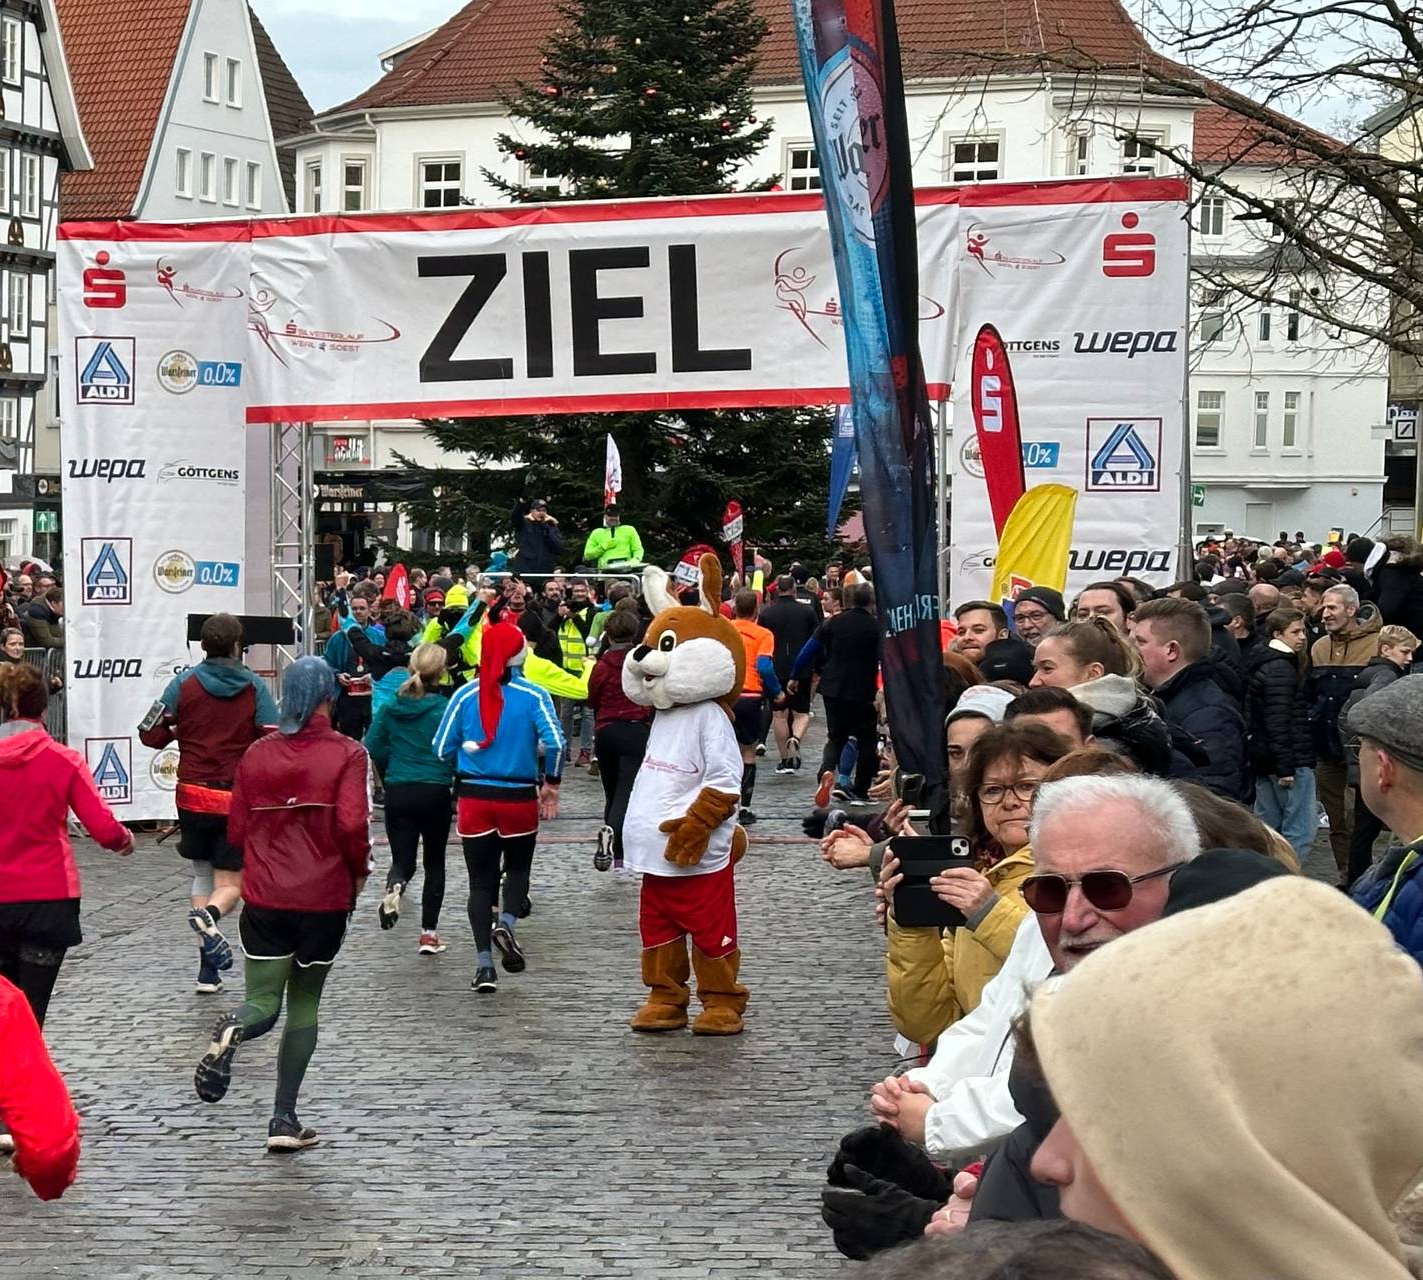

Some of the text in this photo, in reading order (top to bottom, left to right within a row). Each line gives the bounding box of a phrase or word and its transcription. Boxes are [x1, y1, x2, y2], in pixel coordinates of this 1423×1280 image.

[417, 244, 752, 382] ZIEL
[1073, 330, 1177, 358] wepa
[203, 362, 236, 384] 0,0%
[86, 385, 126, 399] ALDI
[67, 457, 146, 483] wepa
[177, 465, 239, 480] GÖTTGENS
[1097, 472, 1150, 485] ALDI
[200, 562, 234, 584] 0,0%
[1068, 549, 1171, 577] wepa
[91, 586, 125, 599] ALDI
[73, 658, 143, 683] wepa
